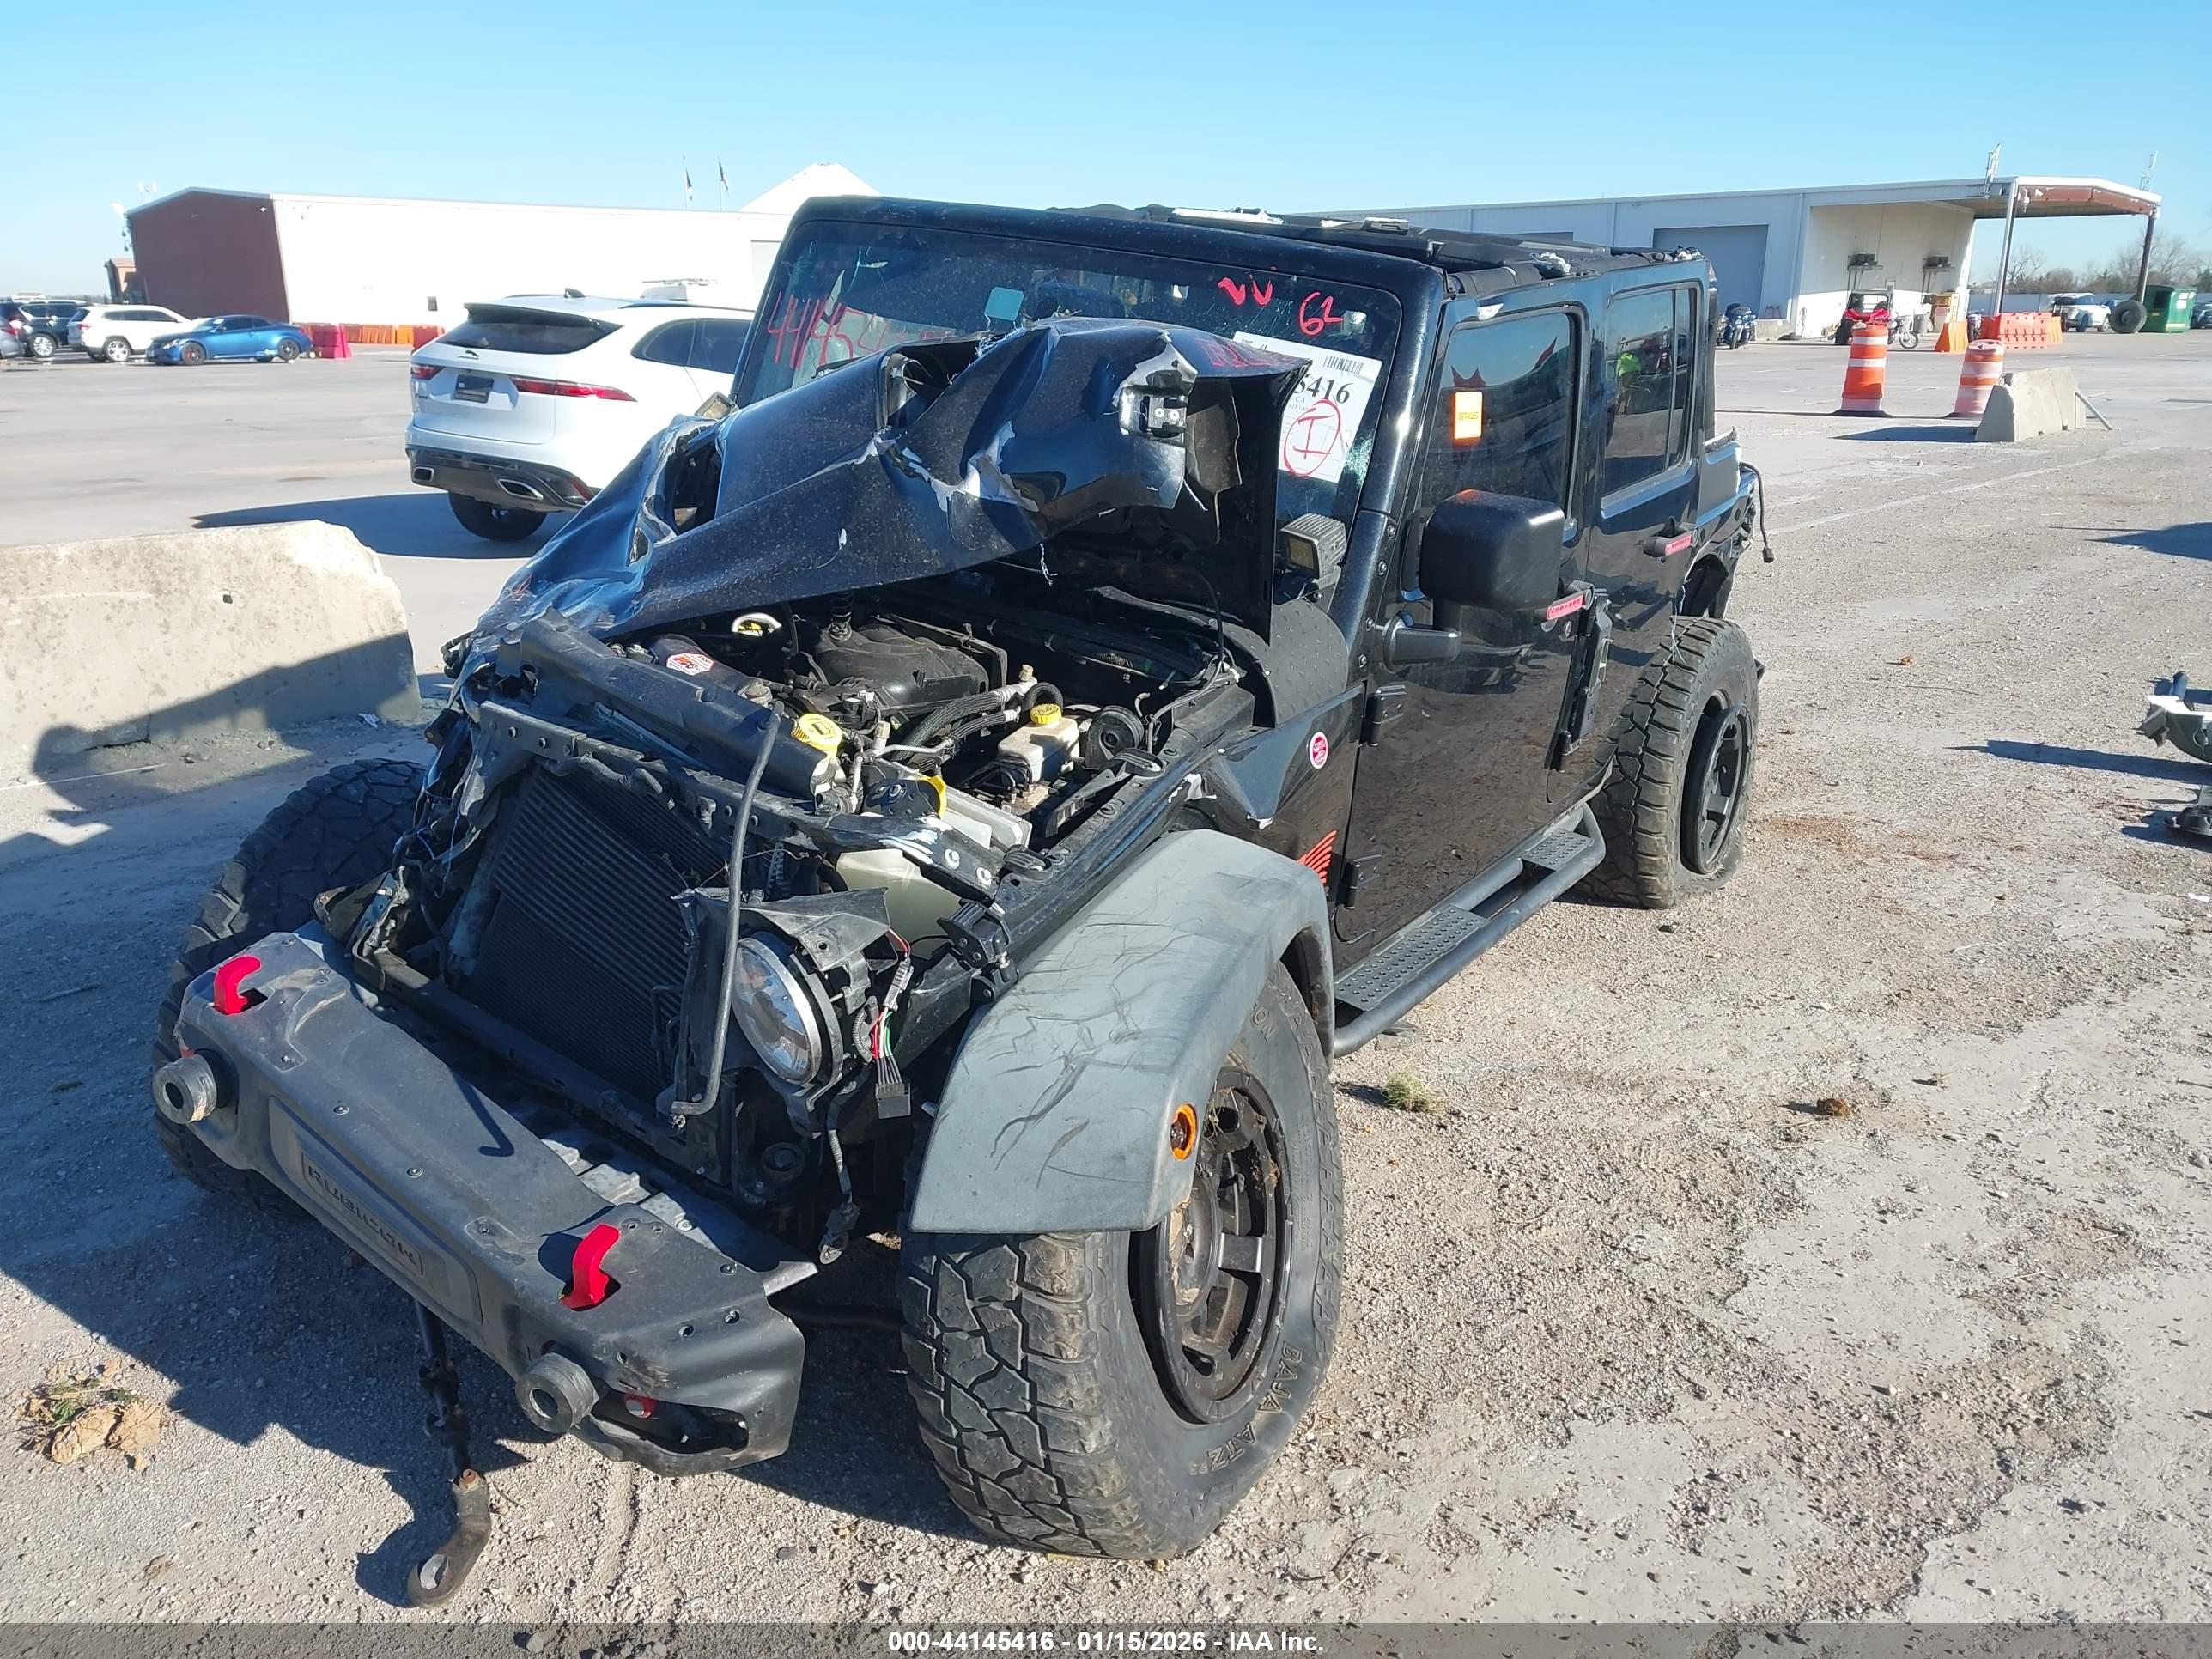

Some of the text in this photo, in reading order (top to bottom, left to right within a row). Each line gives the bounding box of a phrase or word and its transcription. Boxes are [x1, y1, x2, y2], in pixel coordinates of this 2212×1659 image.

[307, 1165, 417, 1266] RUBICON
[1257, 1340, 1303, 1414] BAJA
[1207, 1422, 1256, 1471] ATZ
